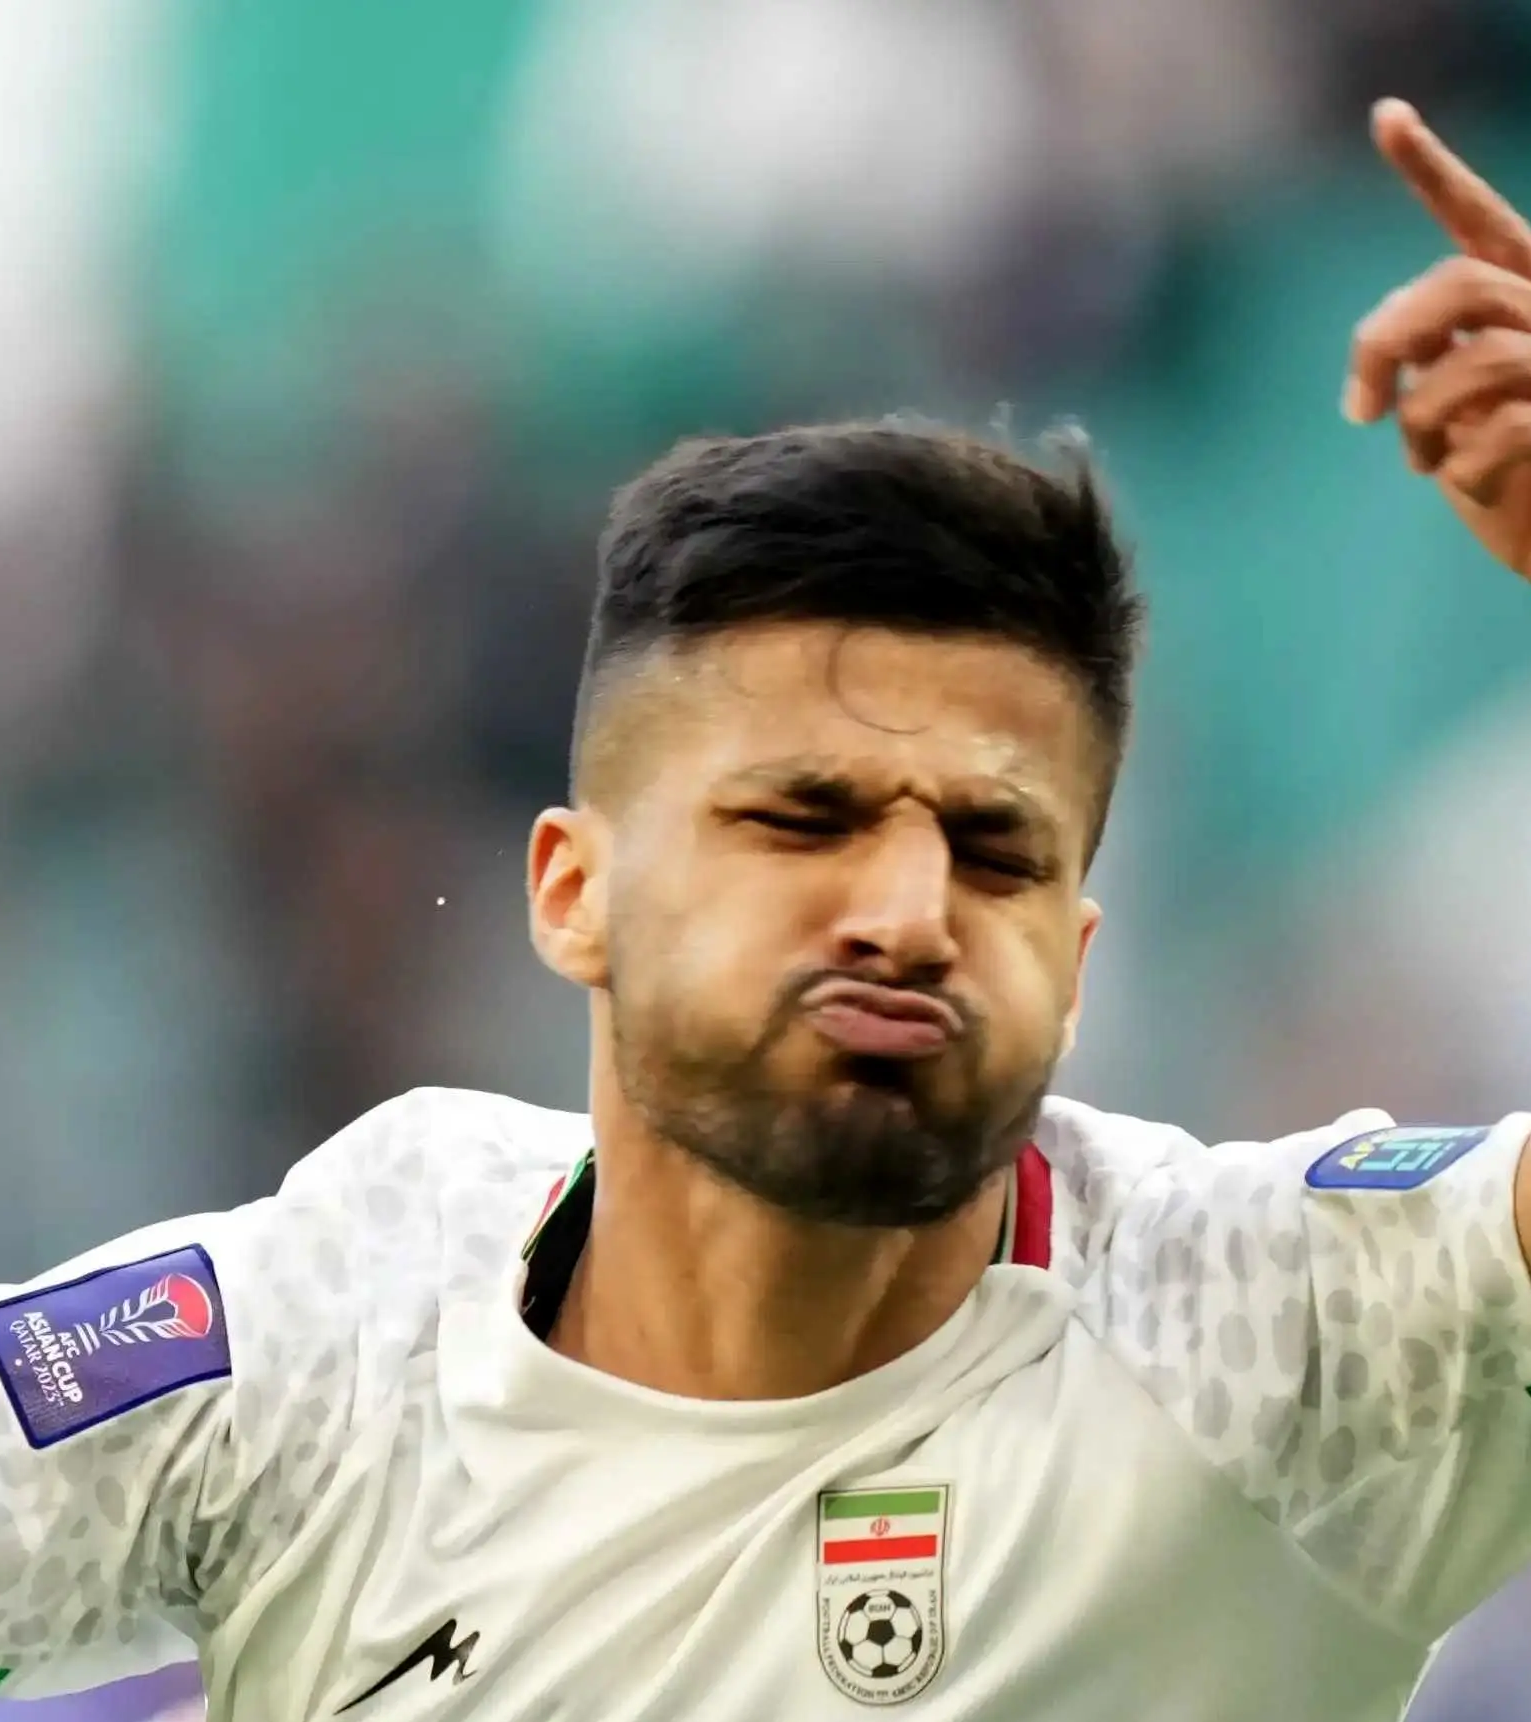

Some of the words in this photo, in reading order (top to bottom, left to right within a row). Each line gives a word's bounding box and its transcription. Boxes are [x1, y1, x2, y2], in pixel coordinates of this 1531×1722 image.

[10, 1320, 42, 1363] QATAR
[23, 1310, 64, 1362] ASIAN
[52, 1361, 83, 1402] CUP
[57, 1331, 82, 1360] AFC
